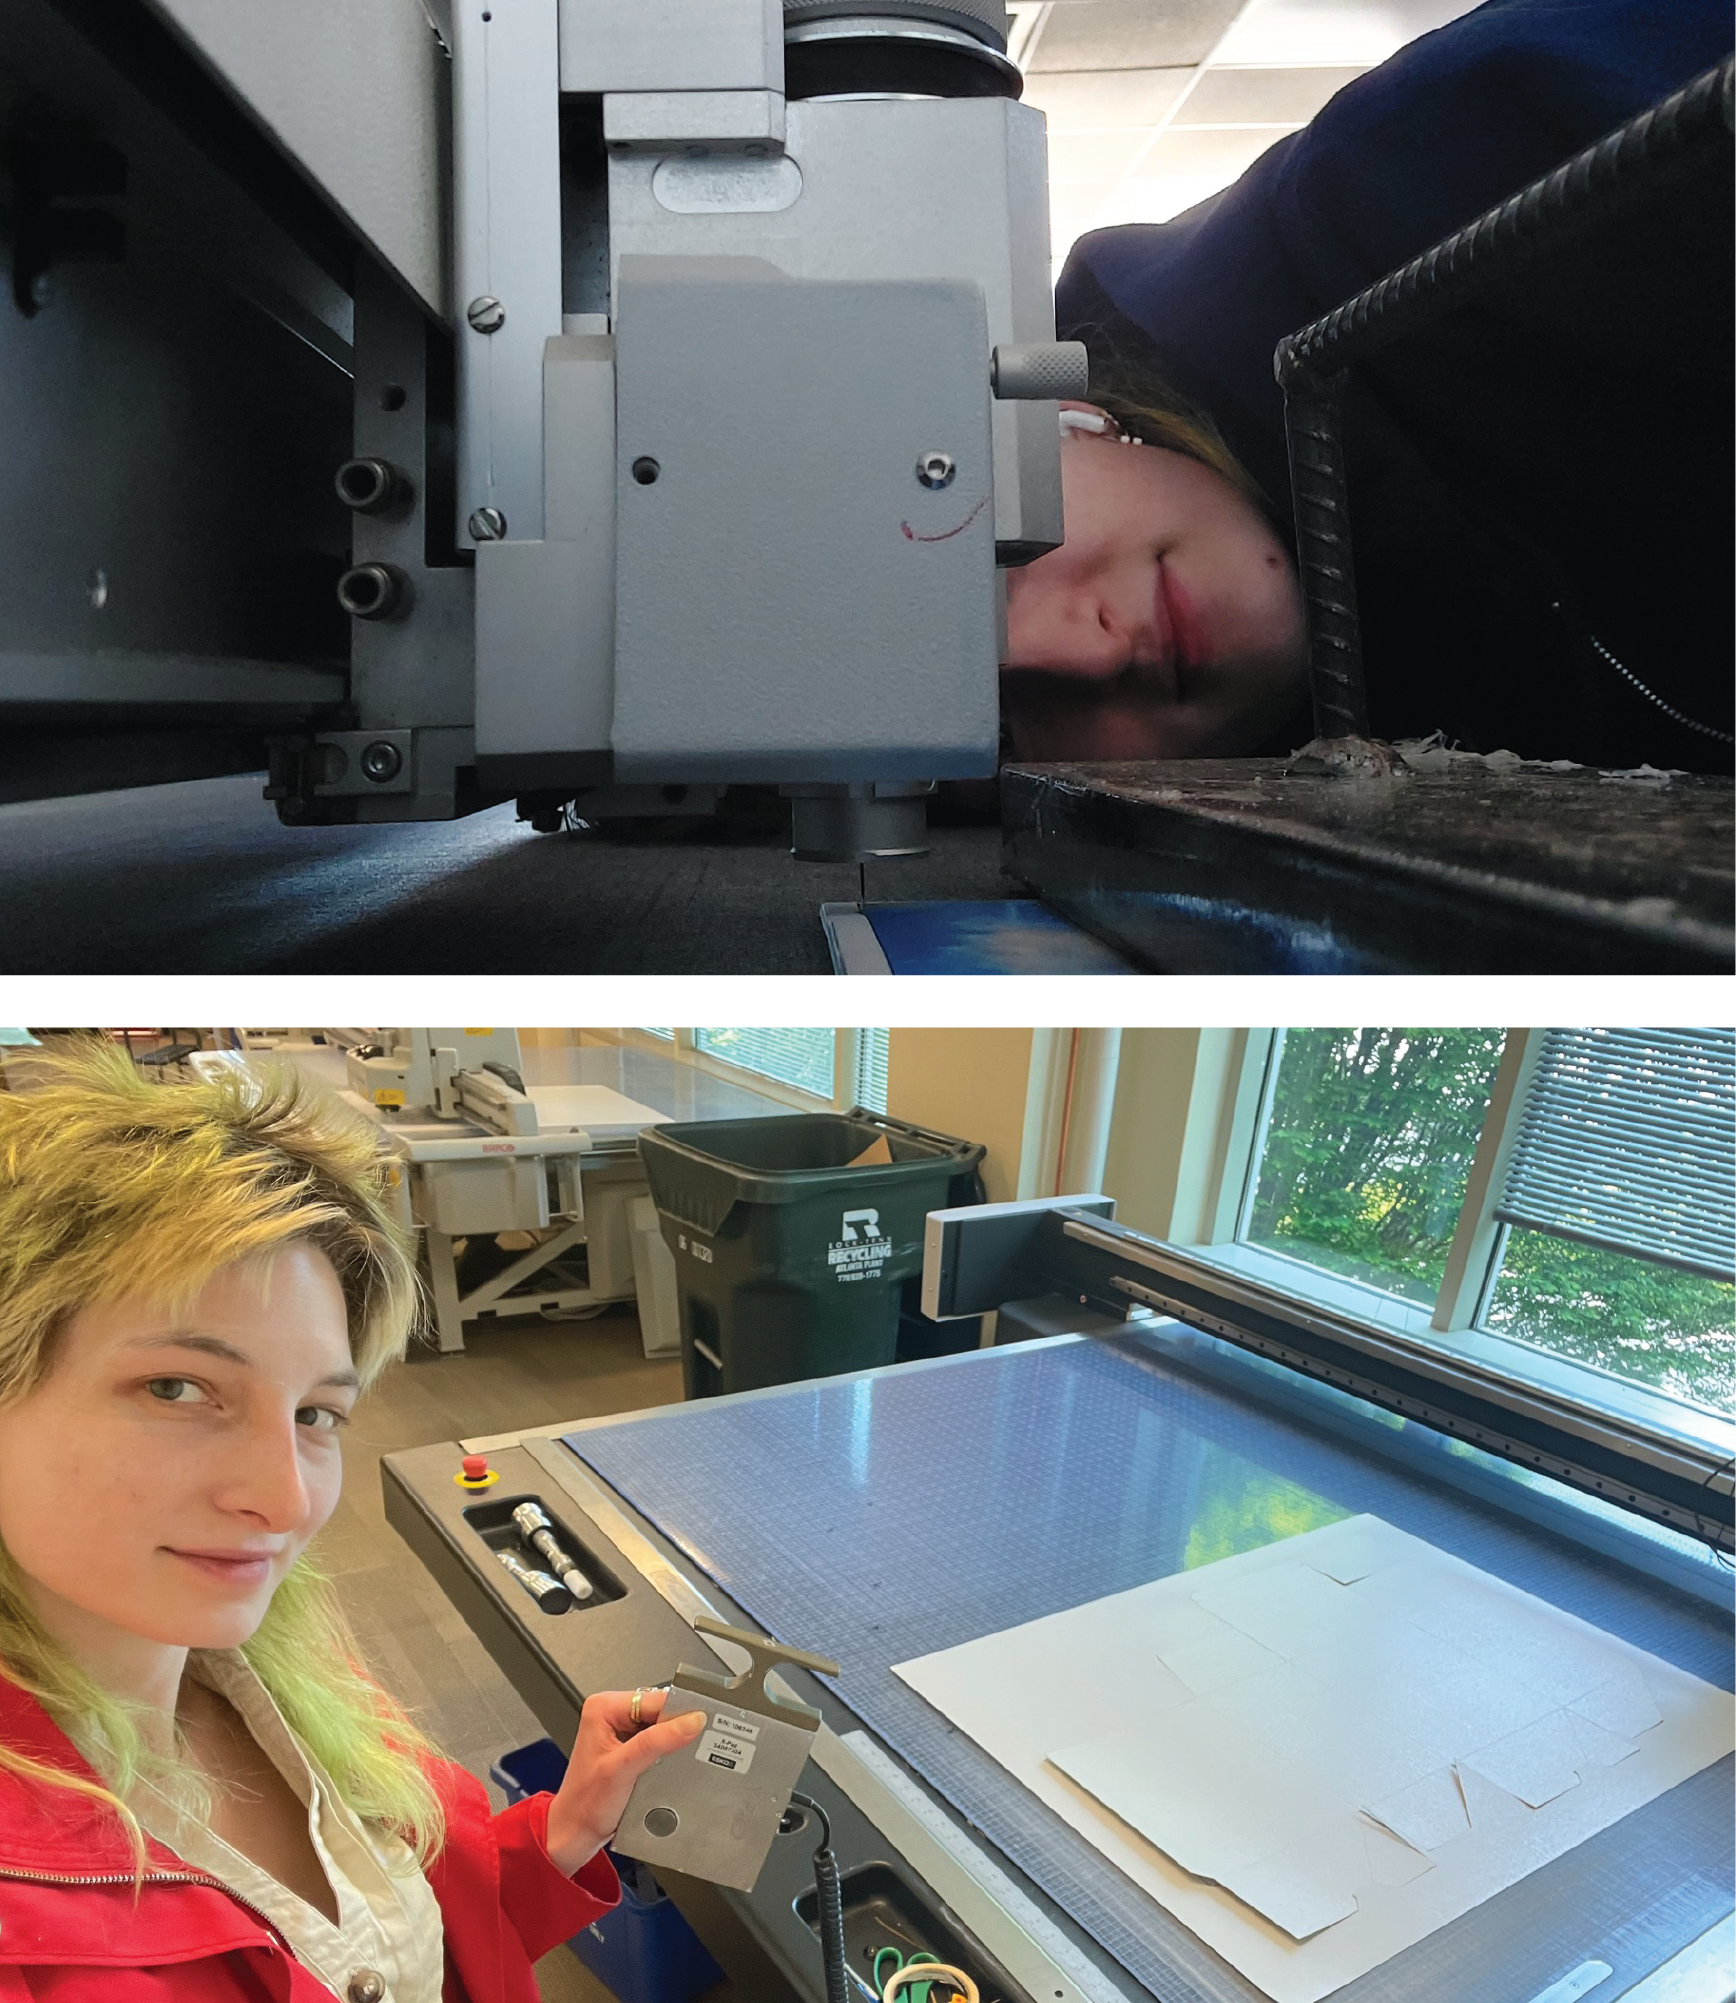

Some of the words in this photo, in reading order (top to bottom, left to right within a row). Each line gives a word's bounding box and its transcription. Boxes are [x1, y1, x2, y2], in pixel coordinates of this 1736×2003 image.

[828, 1244, 892, 1265] RECYCLING
[835, 1261, 864, 1274] ATLANTA
[863, 1259, 884, 1269] PLANT
